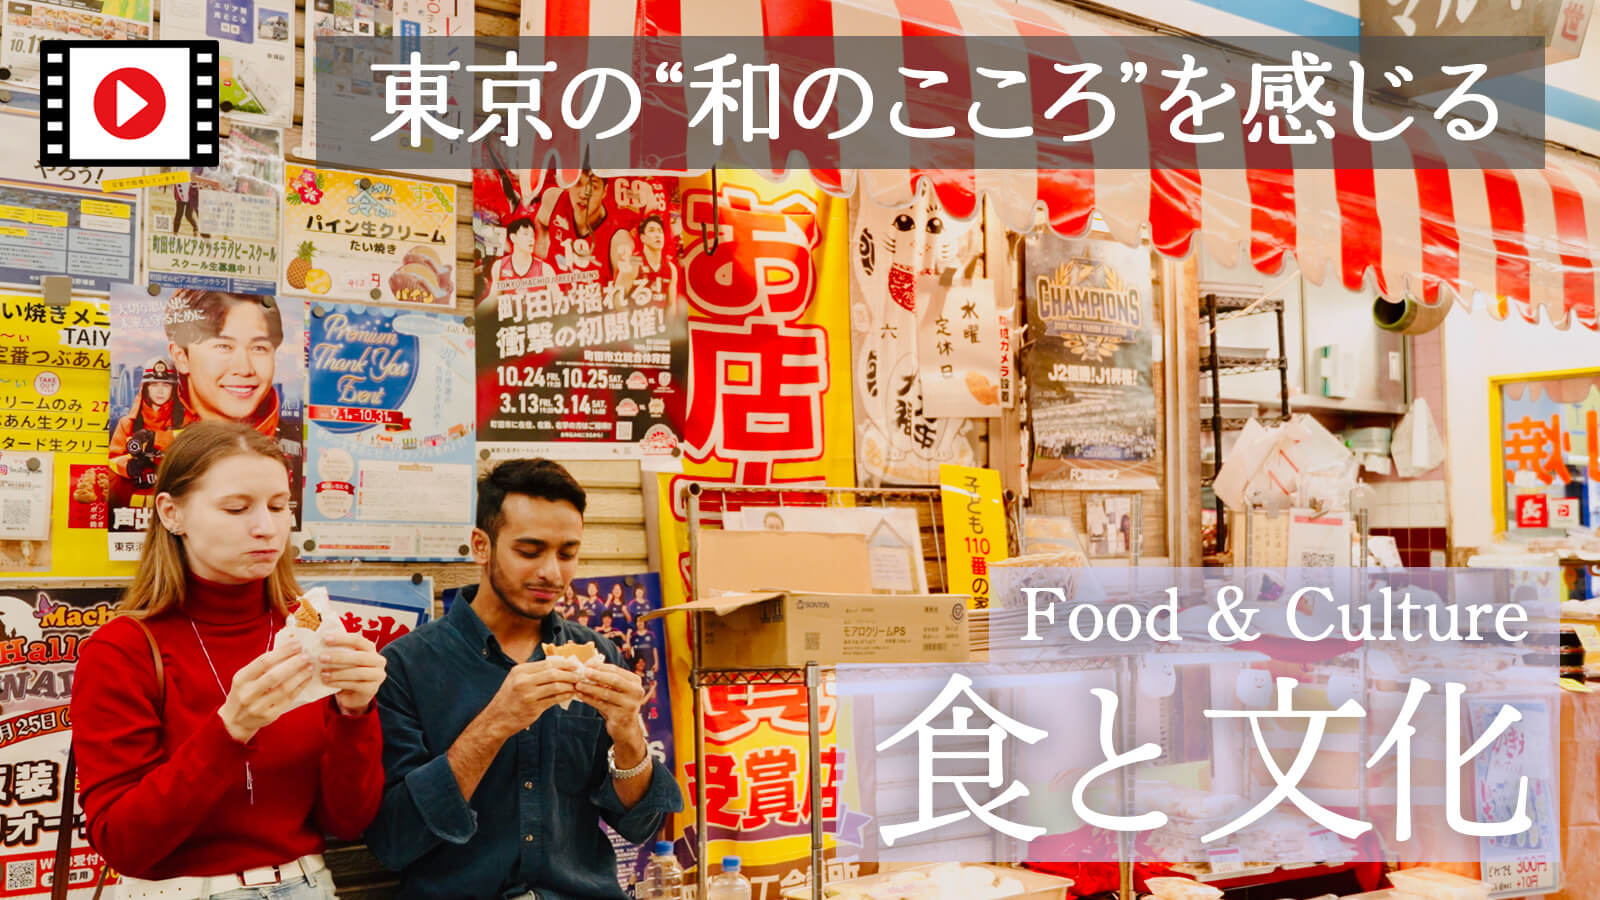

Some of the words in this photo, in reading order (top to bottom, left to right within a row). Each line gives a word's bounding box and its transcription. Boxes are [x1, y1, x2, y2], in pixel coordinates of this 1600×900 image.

[306, 215, 447, 244] パイン生クリーム
[350, 240, 397, 255] たい焼き
[1036, 276, 1140, 328] CHAMPIONS
[324, 313, 398, 346] Premium
[960, 301, 981, 344] 水曜
[313, 343, 369, 373] Thank
[370, 347, 410, 382] You
[936, 314, 954, 380] 定休日
[337, 374, 385, 405] Event
[497, 366, 546, 387] 10.24
[562, 368, 608, 388] 10.25
[500, 393, 540, 414] 3.13
[553, 394, 591, 415] 3.14
